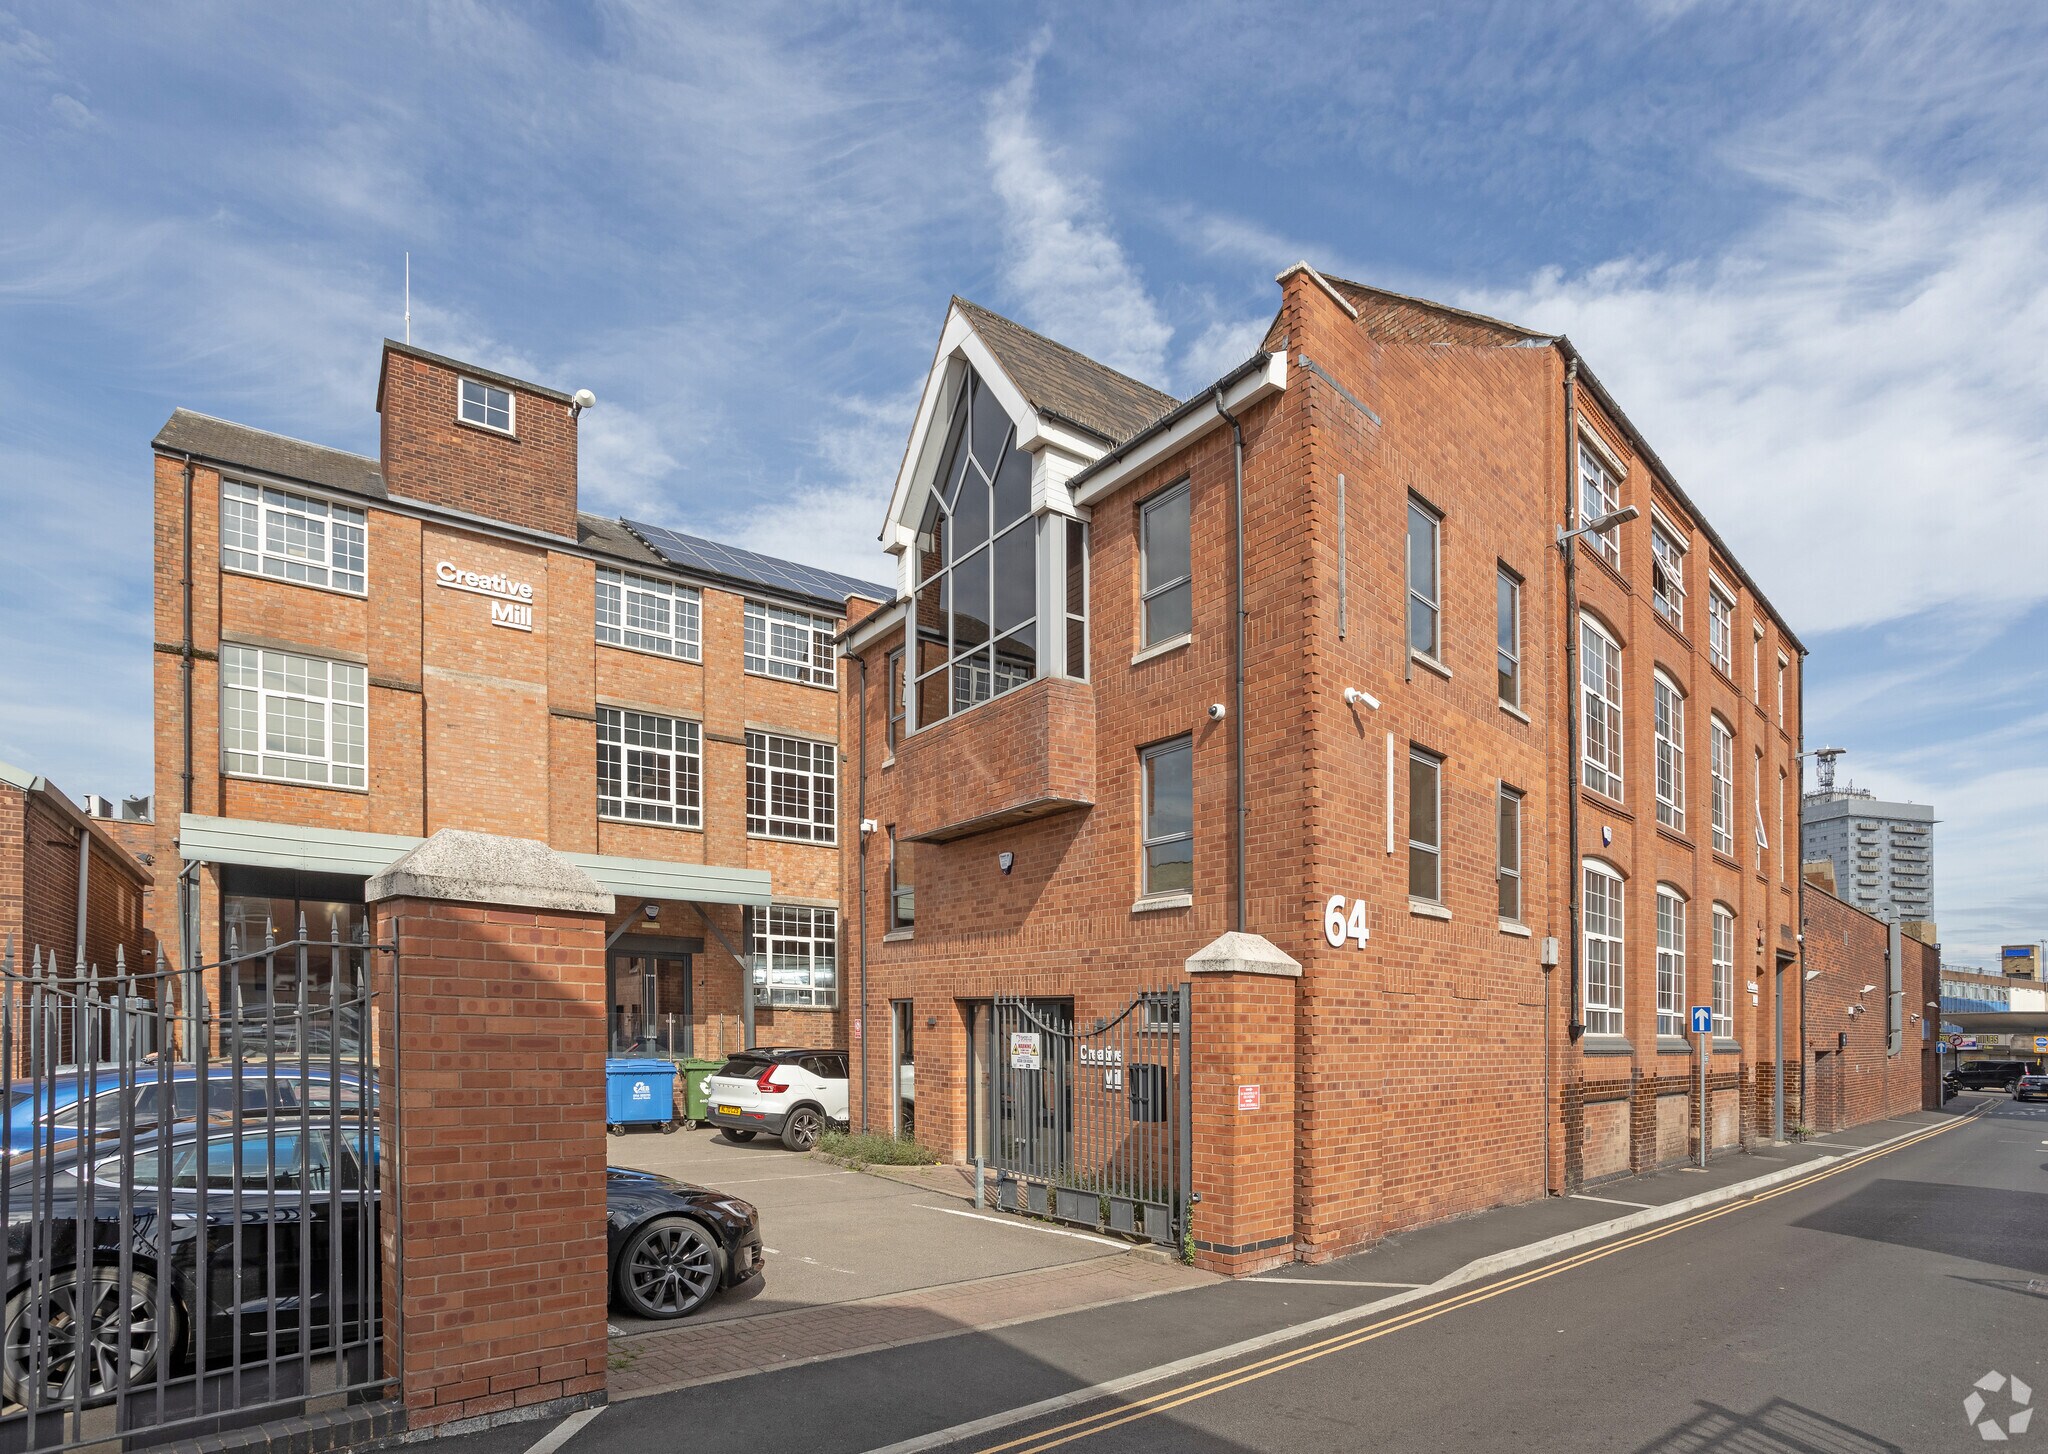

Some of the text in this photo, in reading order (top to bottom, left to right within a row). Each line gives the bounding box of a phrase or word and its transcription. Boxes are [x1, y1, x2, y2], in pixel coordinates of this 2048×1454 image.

[436, 561, 533, 598] Creative
[491, 600, 532, 627] Mill
[1324, 894, 1370, 949] 64
